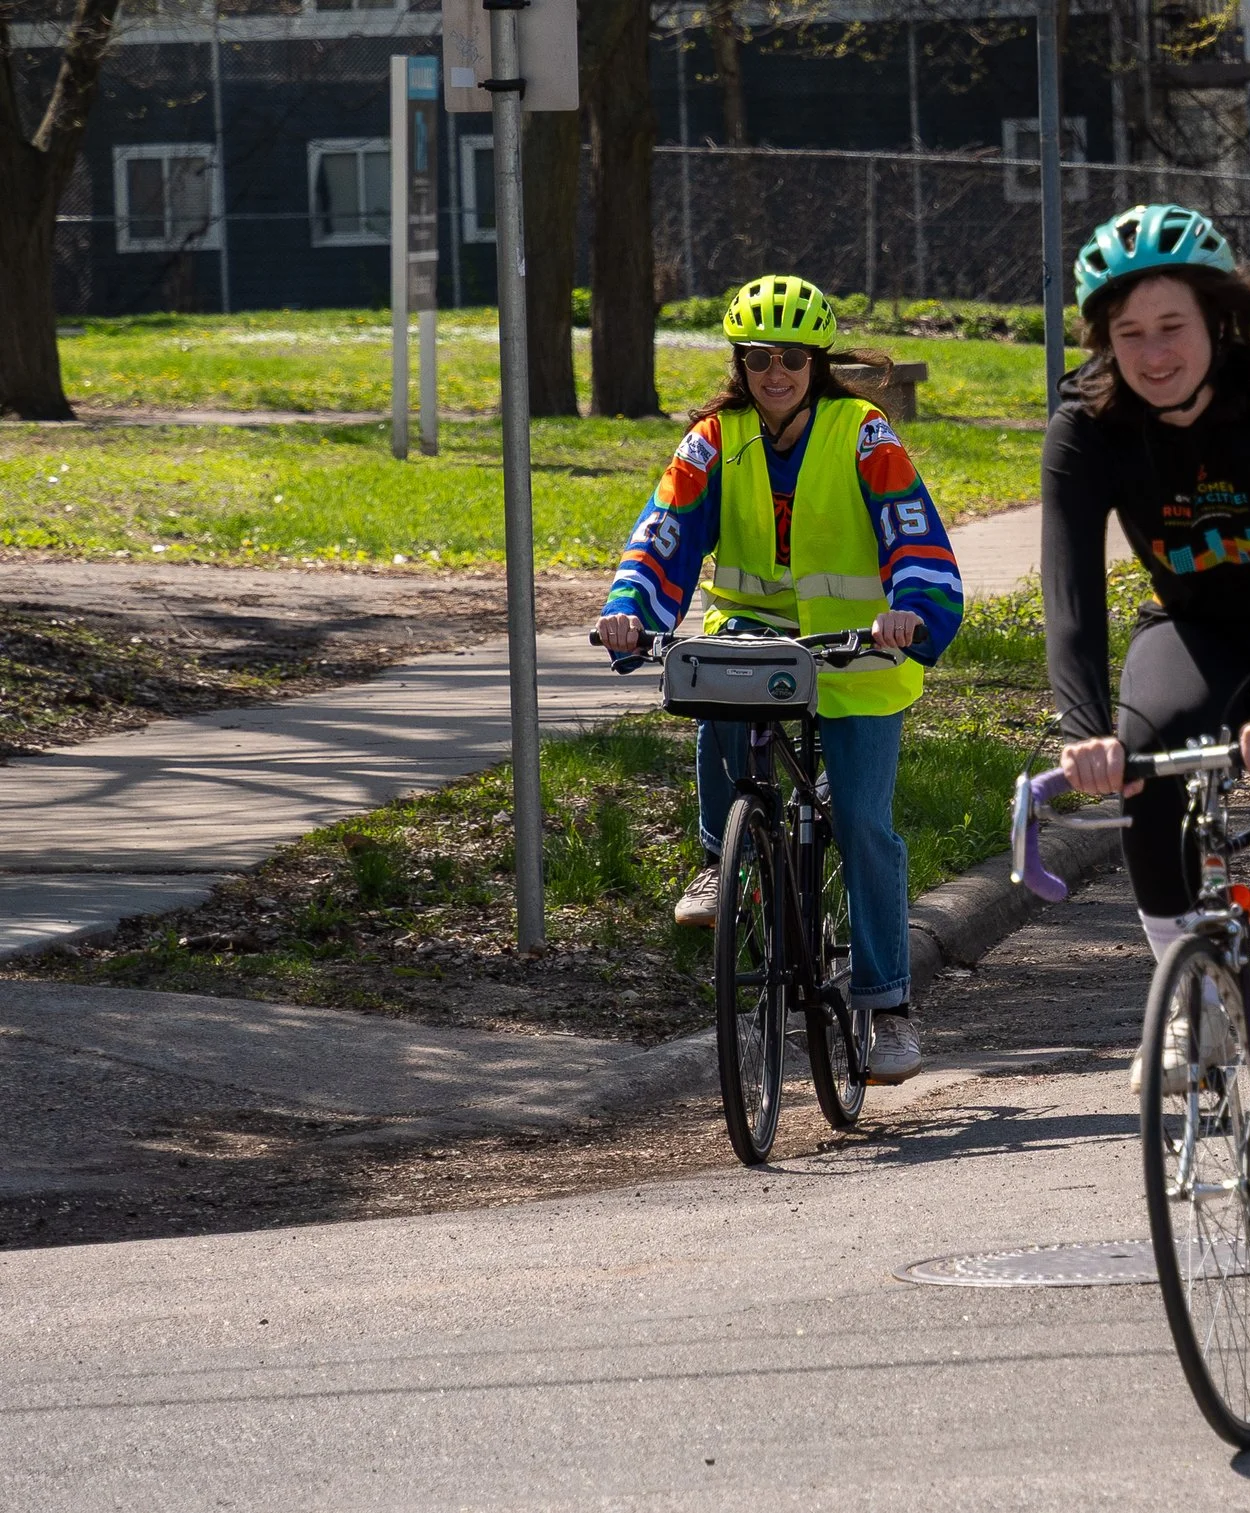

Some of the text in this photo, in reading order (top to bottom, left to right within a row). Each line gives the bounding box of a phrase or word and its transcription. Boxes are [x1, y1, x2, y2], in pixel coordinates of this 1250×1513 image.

[879, 499, 929, 549] 15
[1163, 504, 1192, 518] RUN
[629, 512, 682, 560] 15
